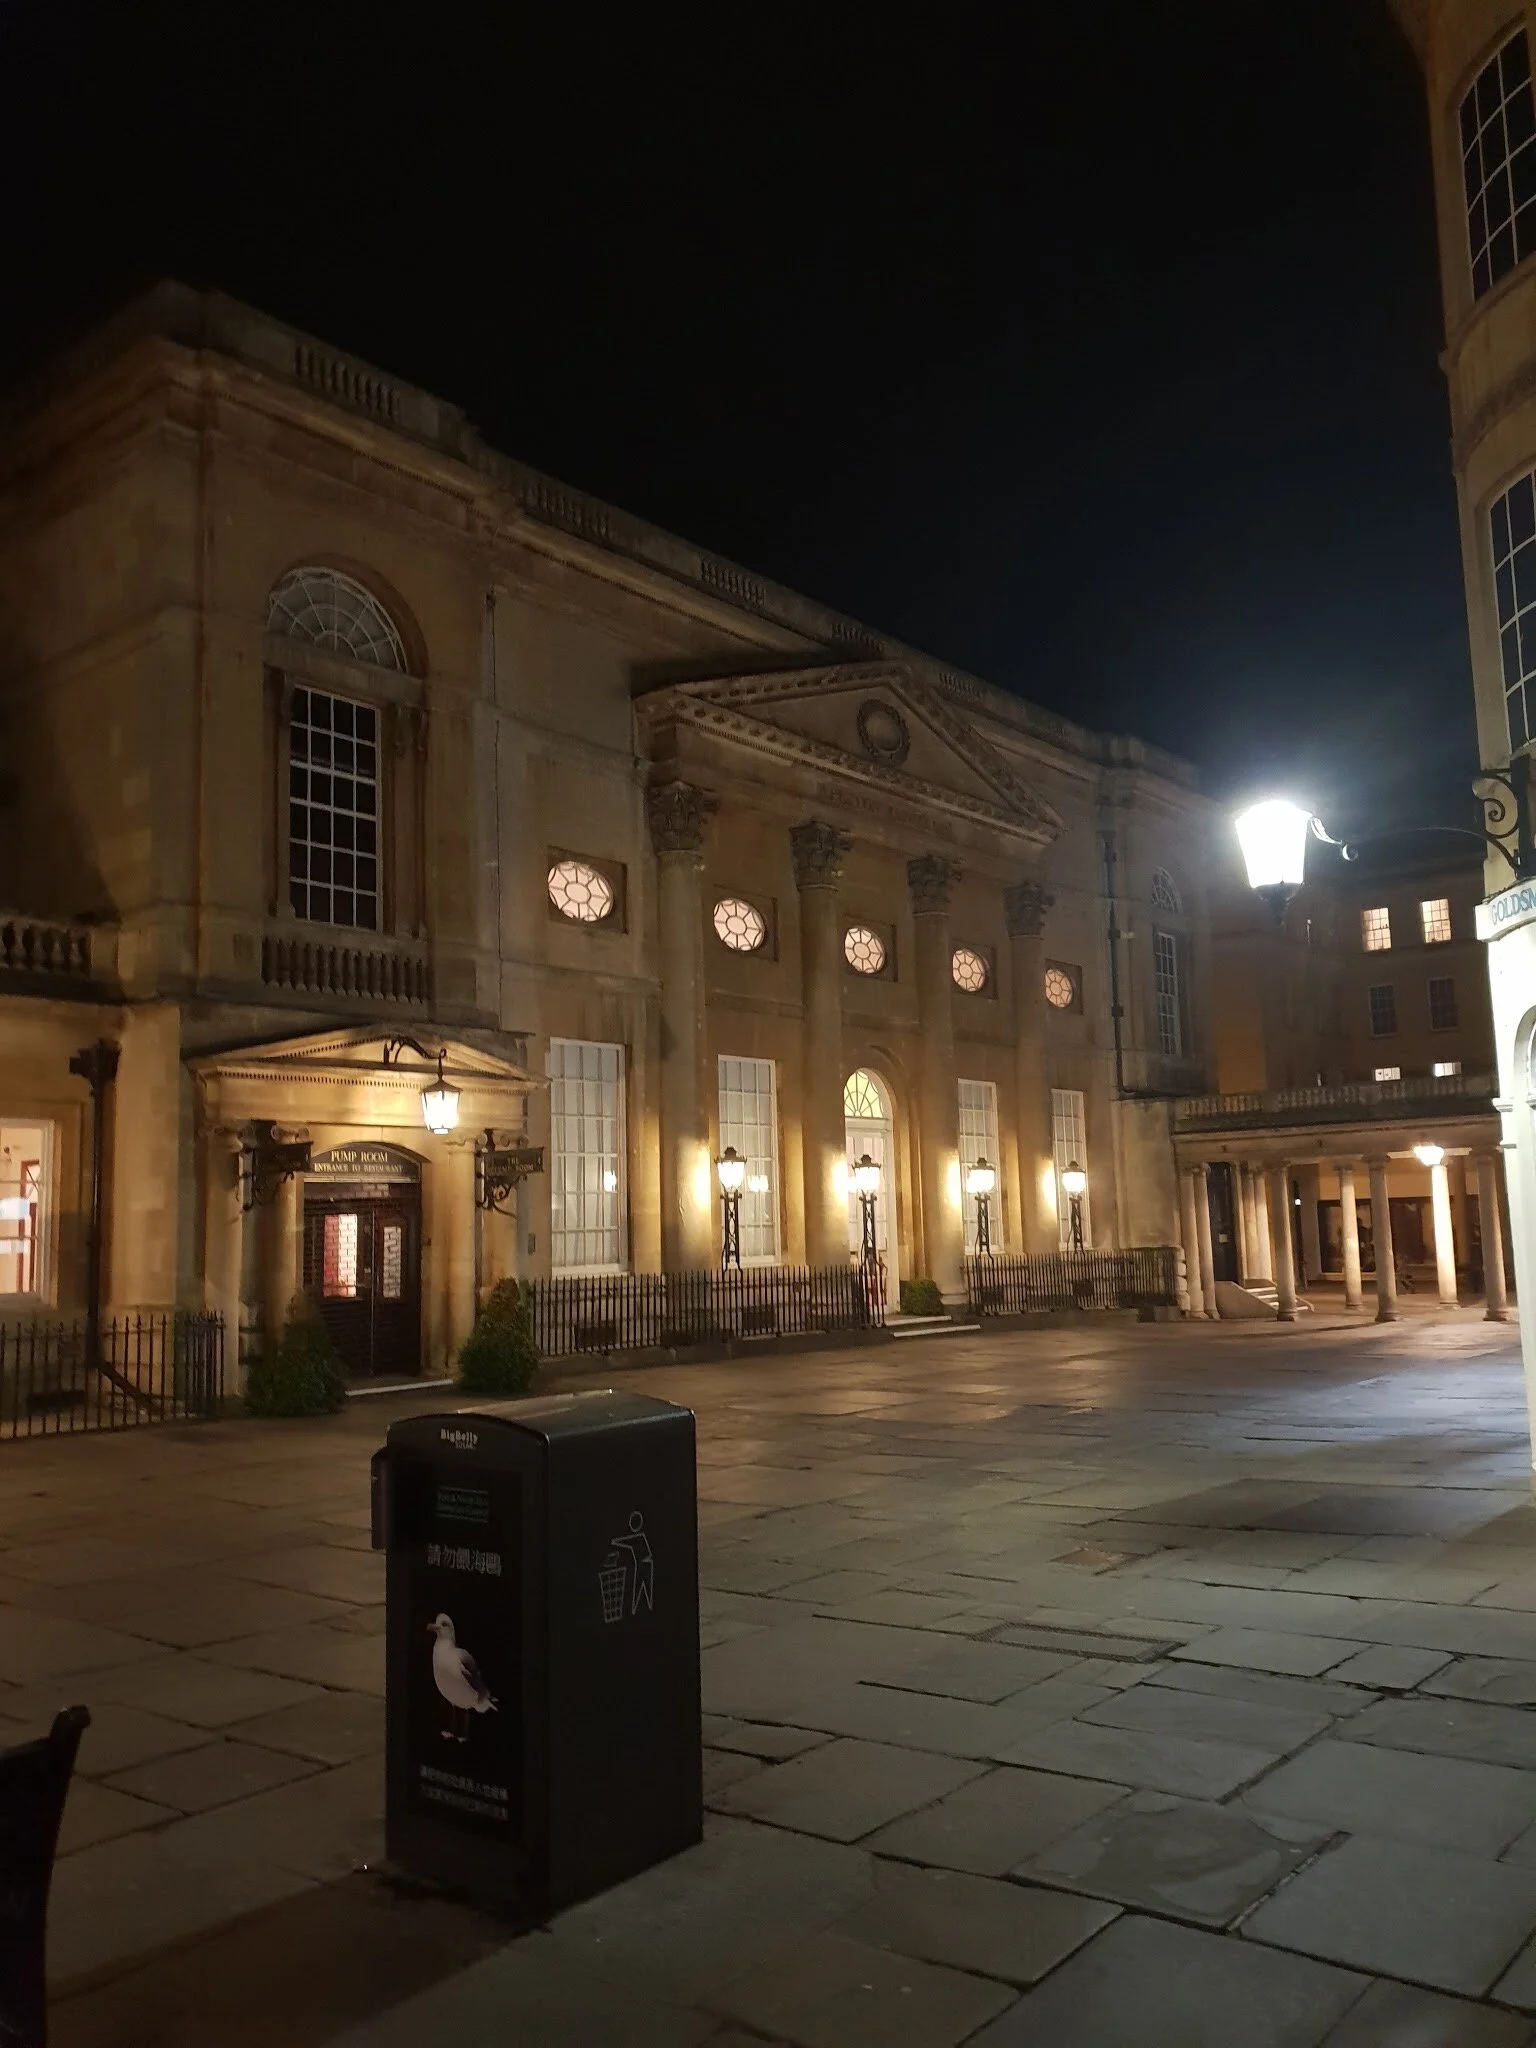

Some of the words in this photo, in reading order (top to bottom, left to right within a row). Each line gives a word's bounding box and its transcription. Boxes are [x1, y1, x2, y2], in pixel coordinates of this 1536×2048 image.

[331, 1150, 357, 1162] PUMP
[361, 1151, 388, 1163] ROOM
[314, 1163, 349, 1173] ENTRANCE
[352, 1164, 361, 1172] TO
[364, 1164, 403, 1173] RESTAURANT
